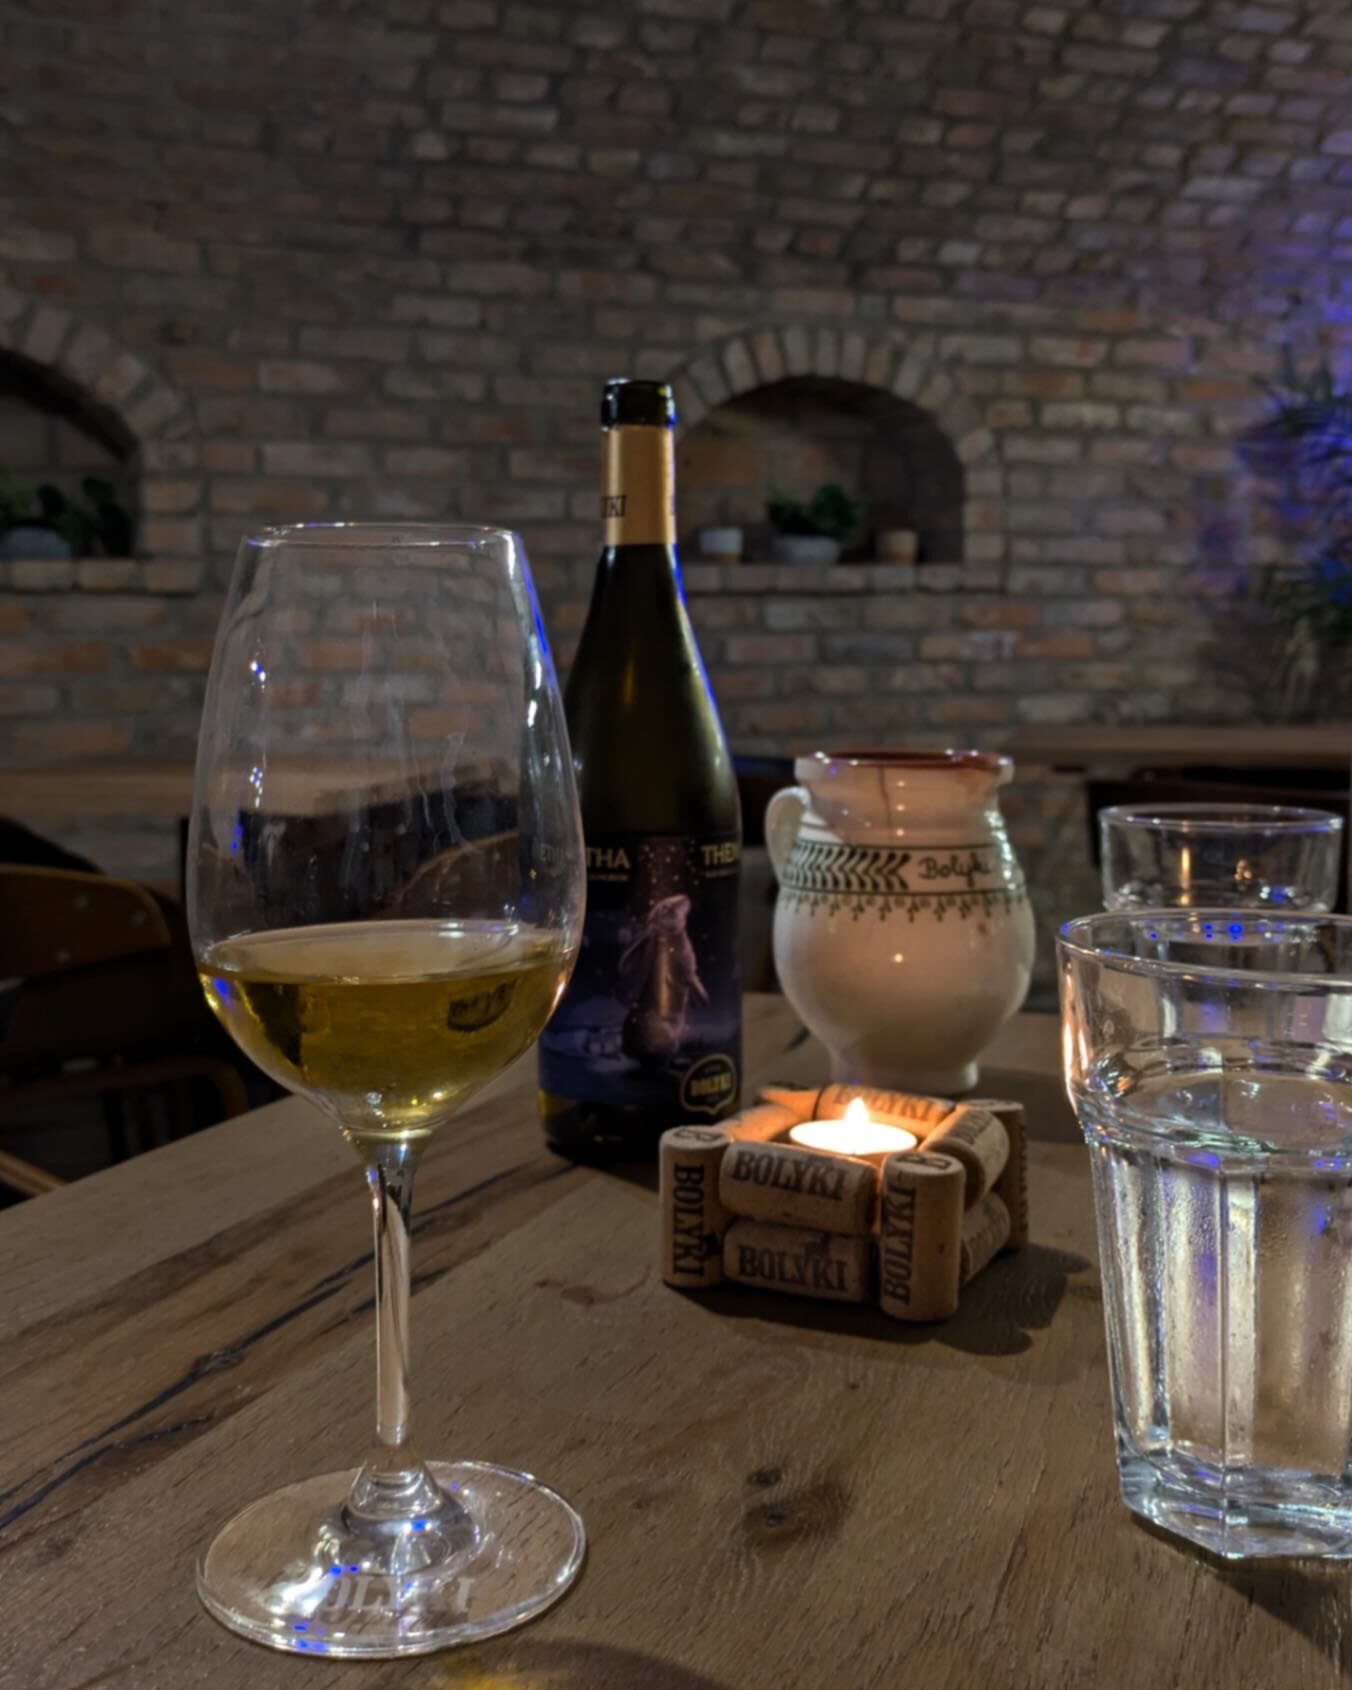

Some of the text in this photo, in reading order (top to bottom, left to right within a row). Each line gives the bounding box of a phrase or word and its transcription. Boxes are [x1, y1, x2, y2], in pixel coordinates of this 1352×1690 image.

[732, 1150, 850, 1201] BOLYKI
[673, 1163, 705, 1277] BOLYKI
[884, 1181, 917, 1306] BOLYKI
[738, 1245, 848, 1291] BOLYKI
